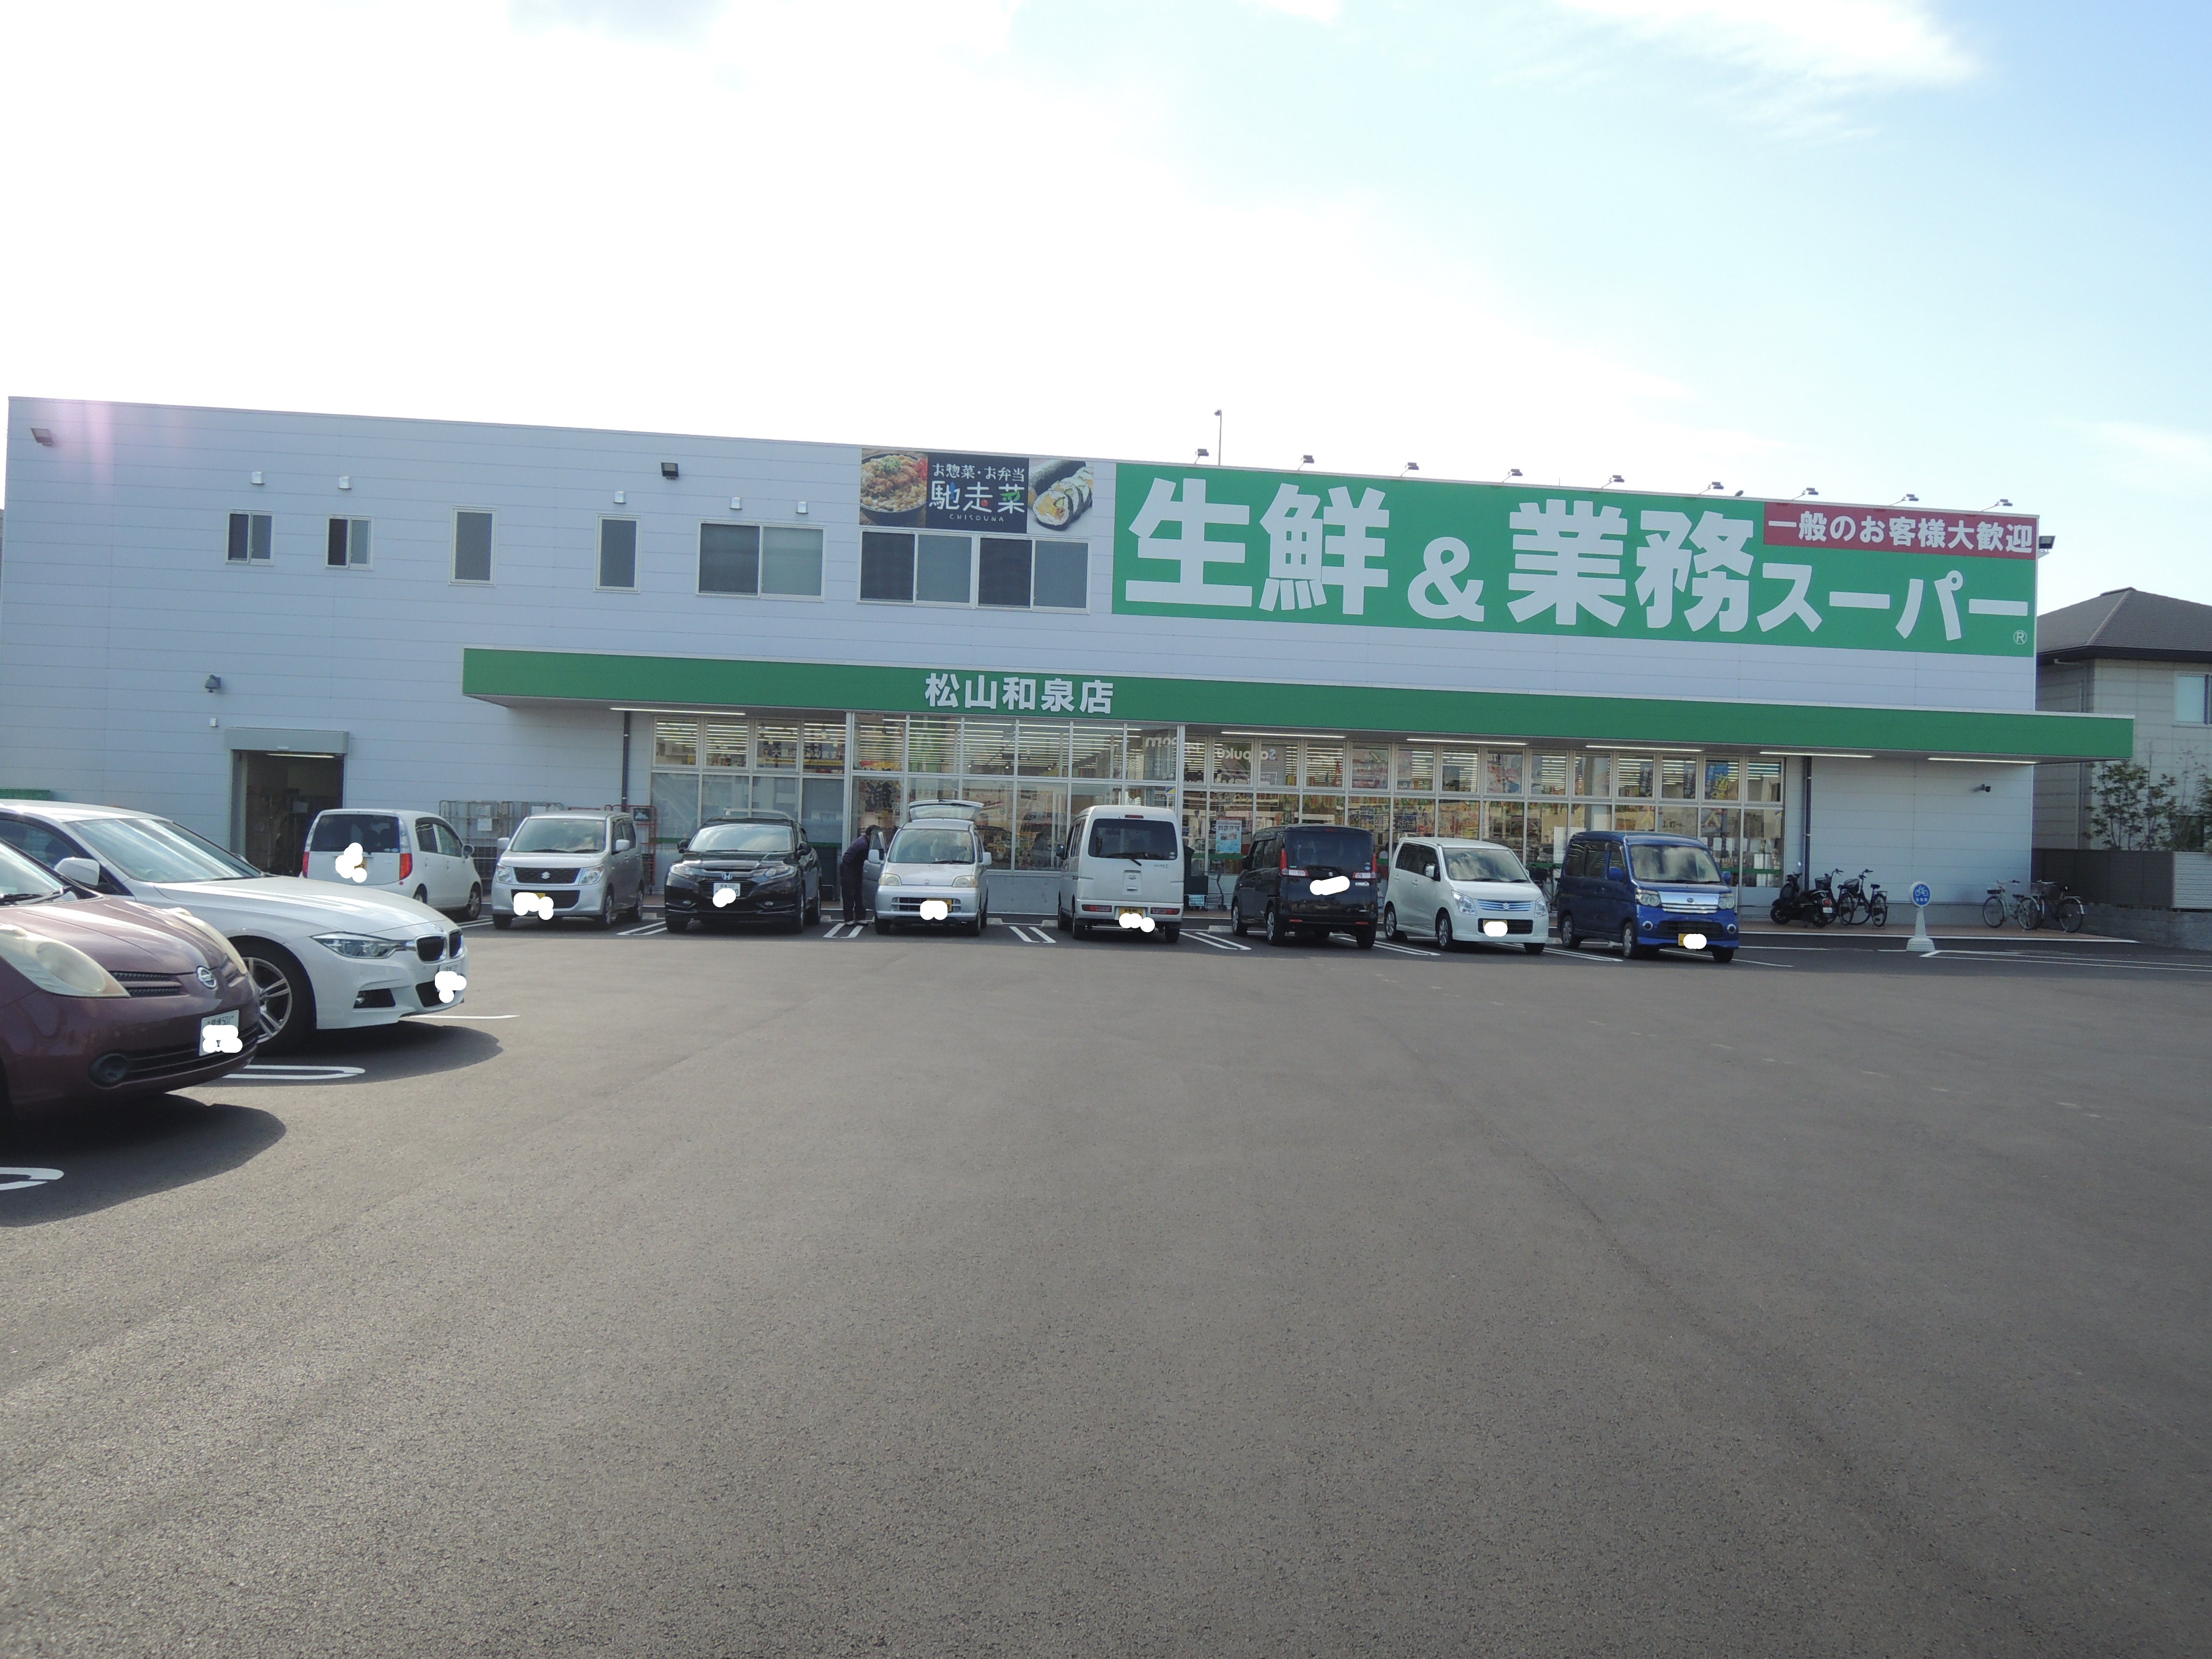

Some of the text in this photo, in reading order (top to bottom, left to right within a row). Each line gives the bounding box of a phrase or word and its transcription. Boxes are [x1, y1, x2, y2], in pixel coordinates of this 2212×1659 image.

[932, 463, 1025, 482] お惣菜・お弁当
[928, 480, 1025, 514] 馳走菜
[949, 514, 1004, 522] CHISOUNA
[1768, 510, 2033, 553] 一般のお客様大歓迎
[924, 673, 1114, 714] 松山和泉店
